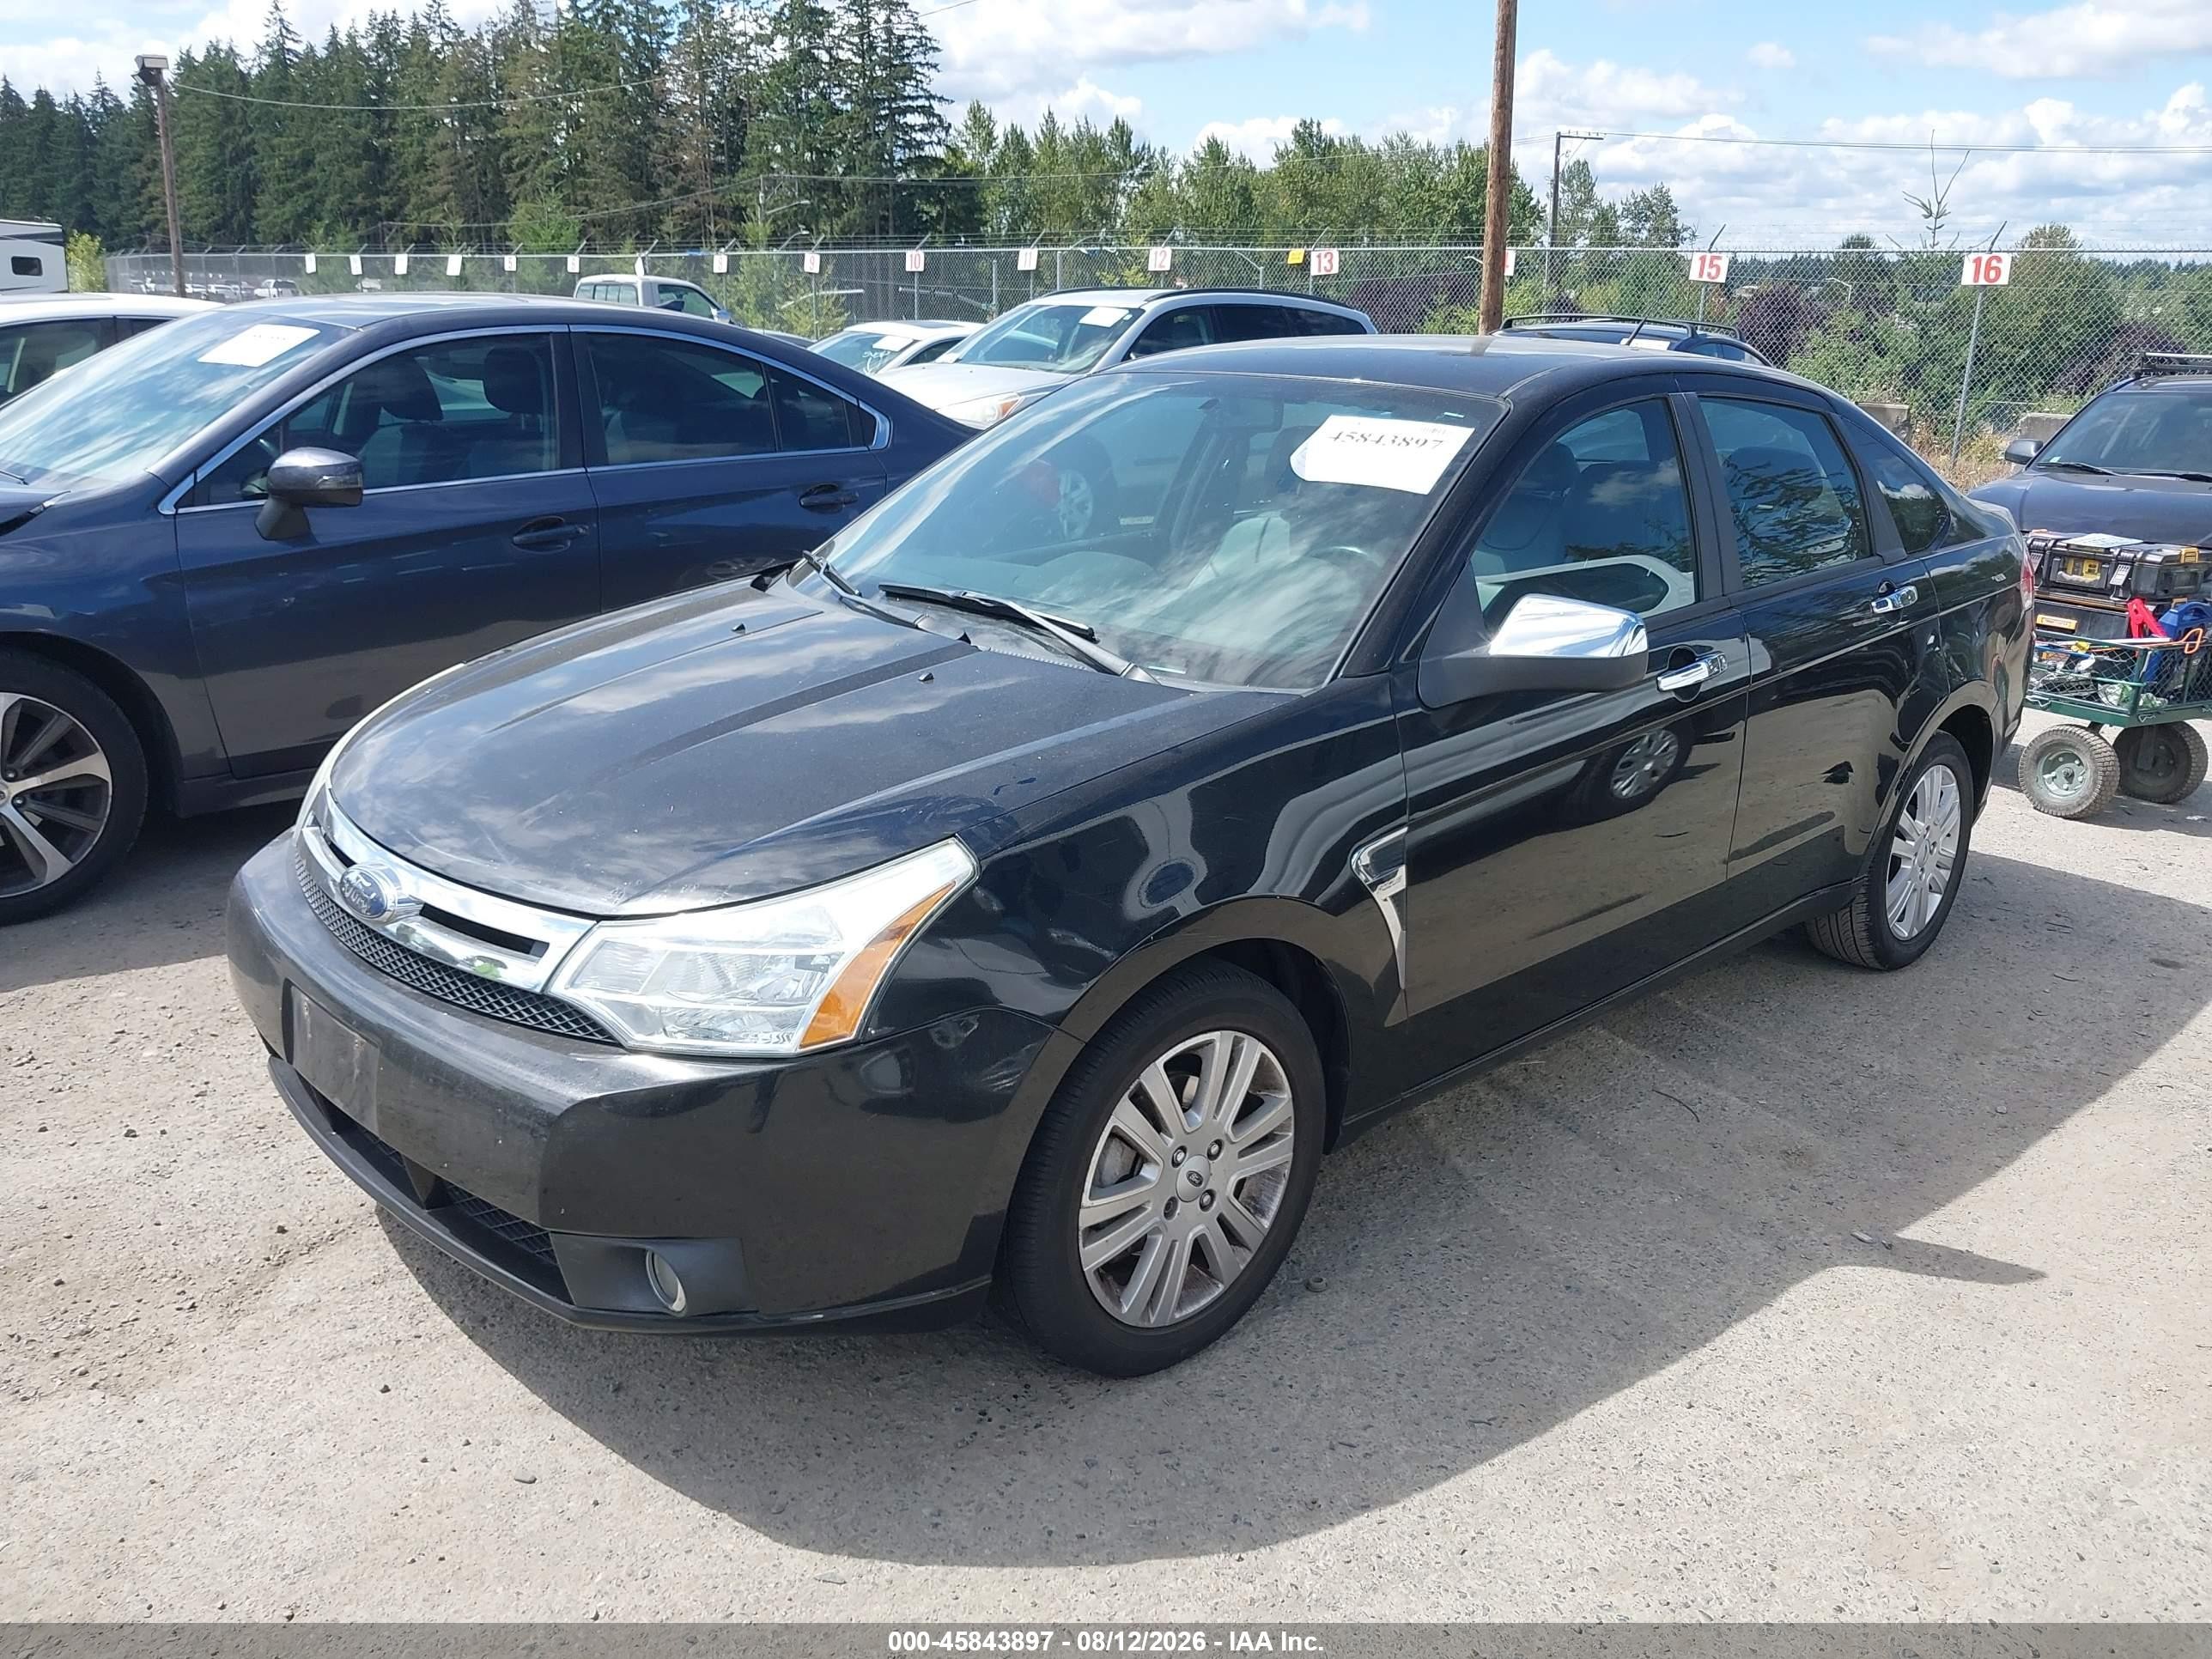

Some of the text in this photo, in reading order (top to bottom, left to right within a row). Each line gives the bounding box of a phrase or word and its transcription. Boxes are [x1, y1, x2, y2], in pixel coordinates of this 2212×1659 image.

[909, 253, 921, 270] 10
[1024, 252, 1032, 269] 11
[1154, 250, 1168, 269] 12
[1316, 252, 1334, 273] 13
[1698, 254, 1723, 280] 15
[1972, 255, 2002, 283] 16
[1328, 431, 1443, 449] 45843897
